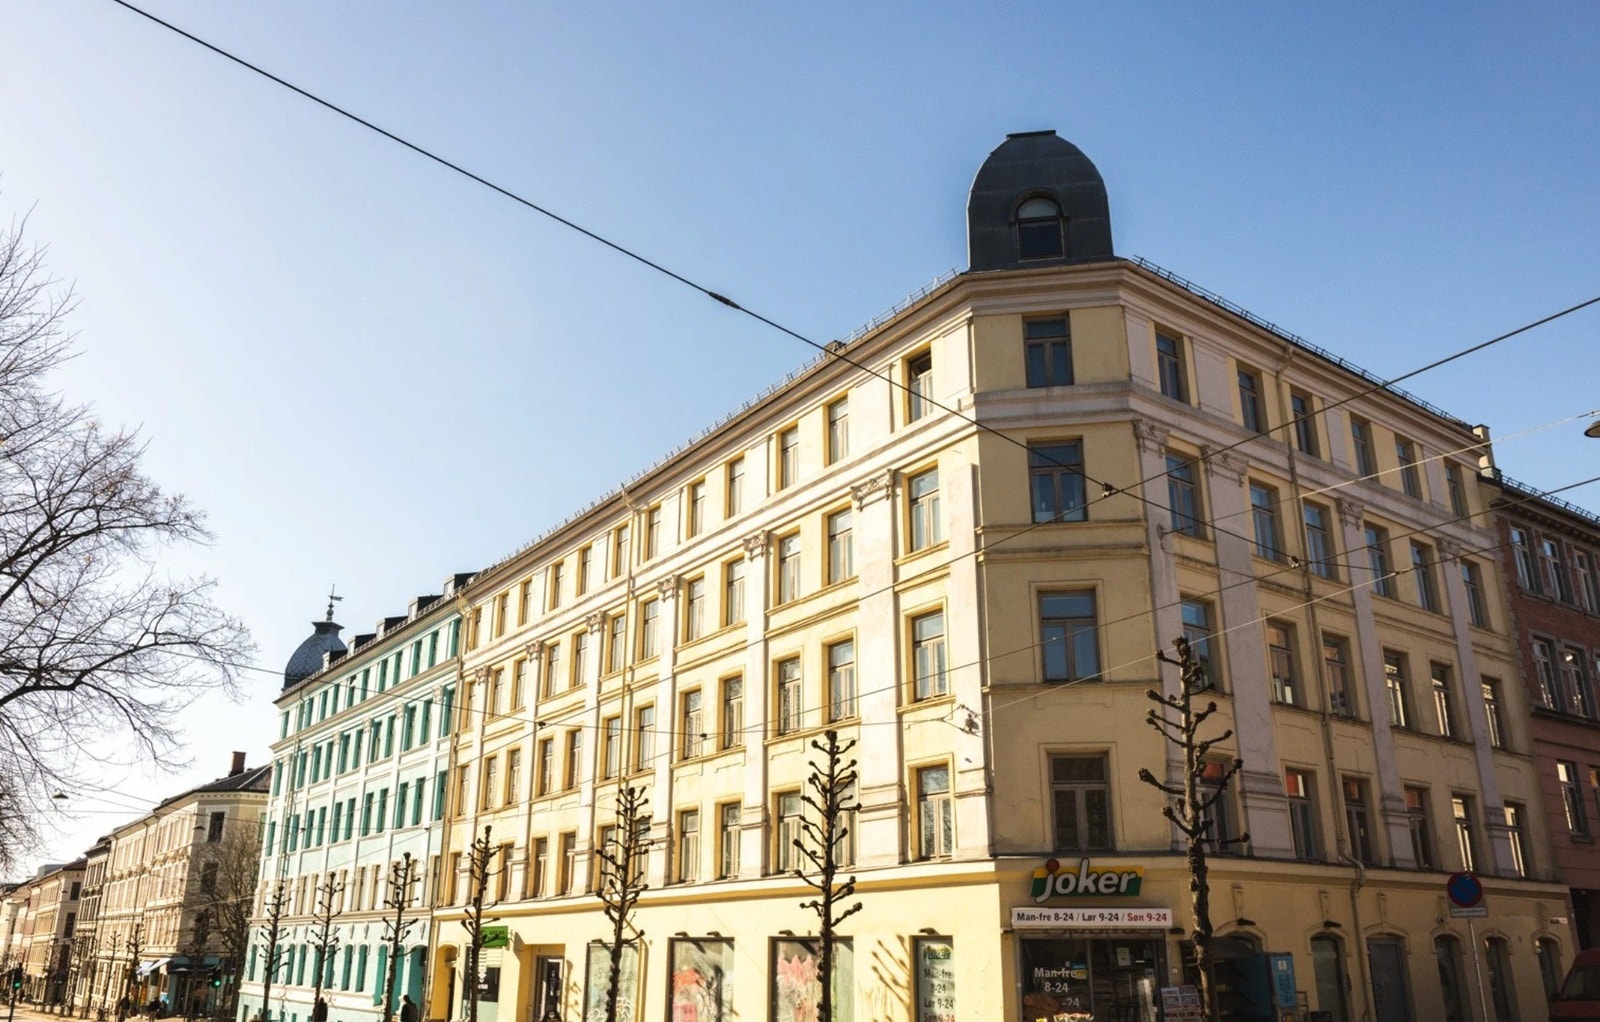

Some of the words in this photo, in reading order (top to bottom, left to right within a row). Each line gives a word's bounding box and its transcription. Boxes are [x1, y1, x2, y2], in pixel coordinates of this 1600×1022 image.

[1035, 858, 1138, 903] joker
[1017, 912, 1051, 921] Man-fre
[1054, 912, 1074, 922] 8-24
[1082, 913, 1096, 922] Lør
[1098, 912, 1119, 922] 9-24
[1127, 912, 1144, 921] Søn
[1146, 912, 1167, 921] 9-24
[1034, 967, 1076, 978] Man-fre
[930, 984, 946, 993] 8-24
[1044, 982, 1069, 993] 8-24
[937, 999, 953, 1009] 9-24
